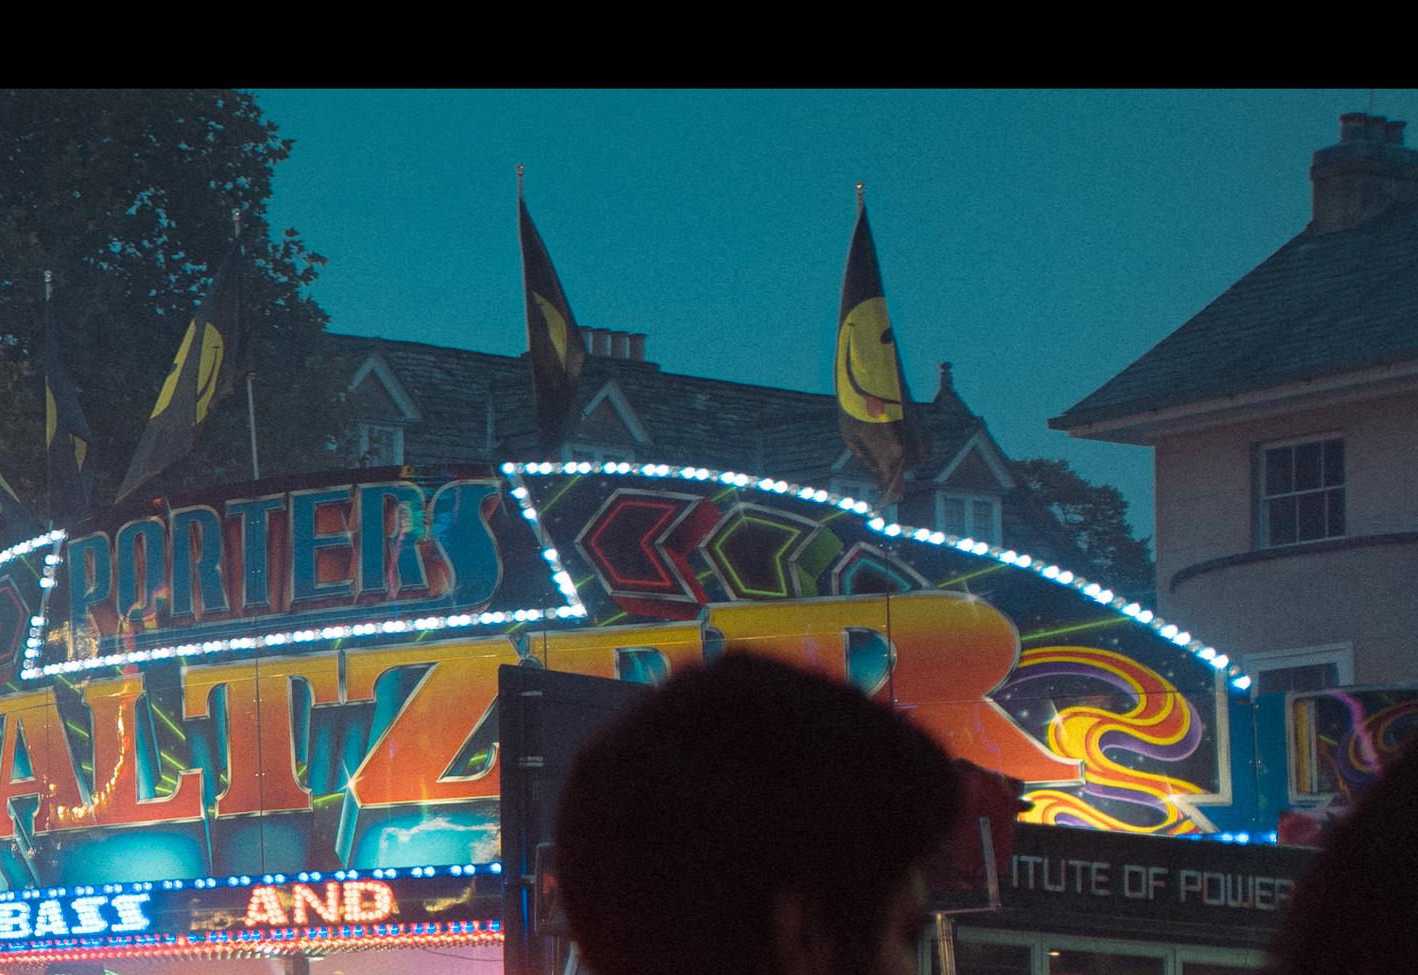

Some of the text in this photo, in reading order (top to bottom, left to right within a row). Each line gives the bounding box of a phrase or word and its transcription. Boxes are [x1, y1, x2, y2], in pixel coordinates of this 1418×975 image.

[67, 480, 504, 628] PORTERS
[244, 881, 396, 926] AND
[1123, 864, 1169, 900] OF
